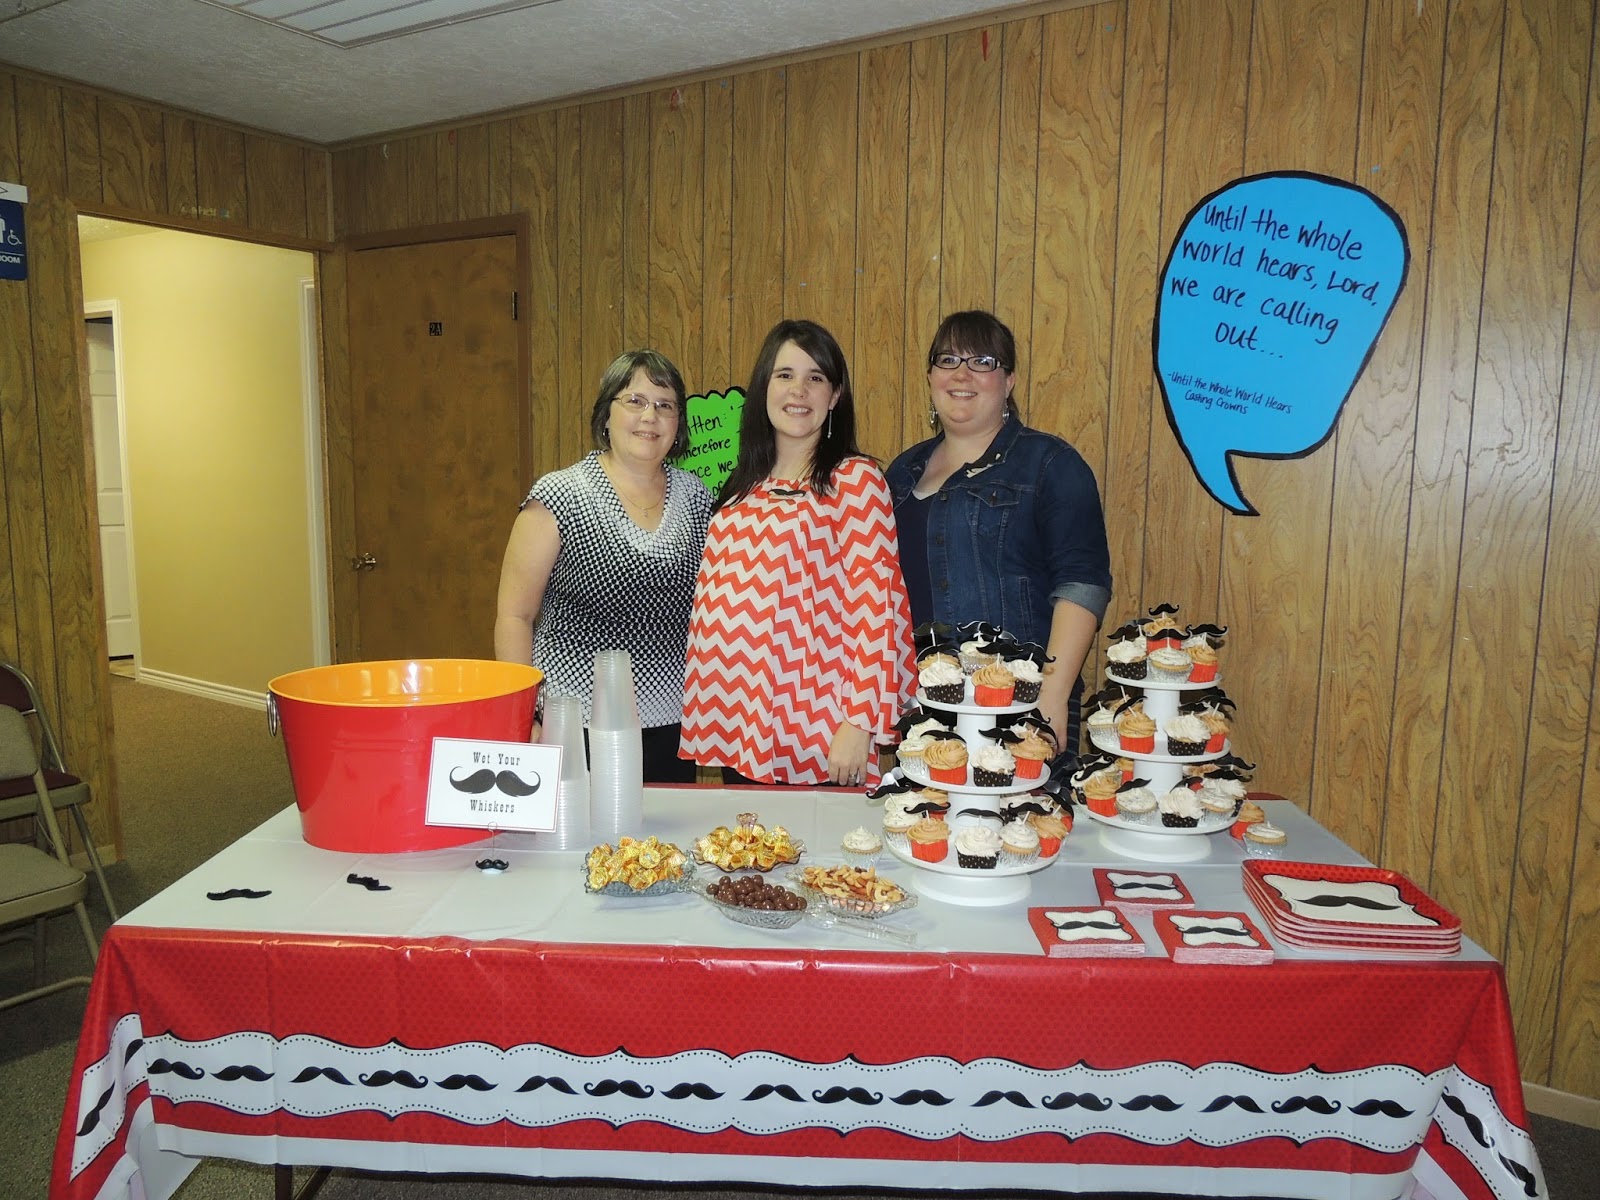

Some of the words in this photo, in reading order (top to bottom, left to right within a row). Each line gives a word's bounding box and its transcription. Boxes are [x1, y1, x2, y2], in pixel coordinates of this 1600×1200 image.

[1204, 204, 1248, 232] Until
[1251, 208, 1290, 241] the
[1298, 221, 1363, 260] whole
[1256, 248, 1317, 290] hears,
[1327, 270, 1380, 306] Lord,
[1171, 276, 1200, 297] we
[1213, 284, 1246, 308] are
[1260, 297, 1339, 345] calling
[430, 322, 442, 336] 2A
[1185, 389, 1213, 410] Casting
[1216, 398, 1249, 415] Crowns
[1194, 377, 1207, 390] the
[1209, 381, 1233, 397] Whole
[1264, 396, 1293, 414] Hears
[473, 751, 491, 764] Wet
[498, 753, 521, 766] Your
[470, 799, 515, 813] Whiskers
